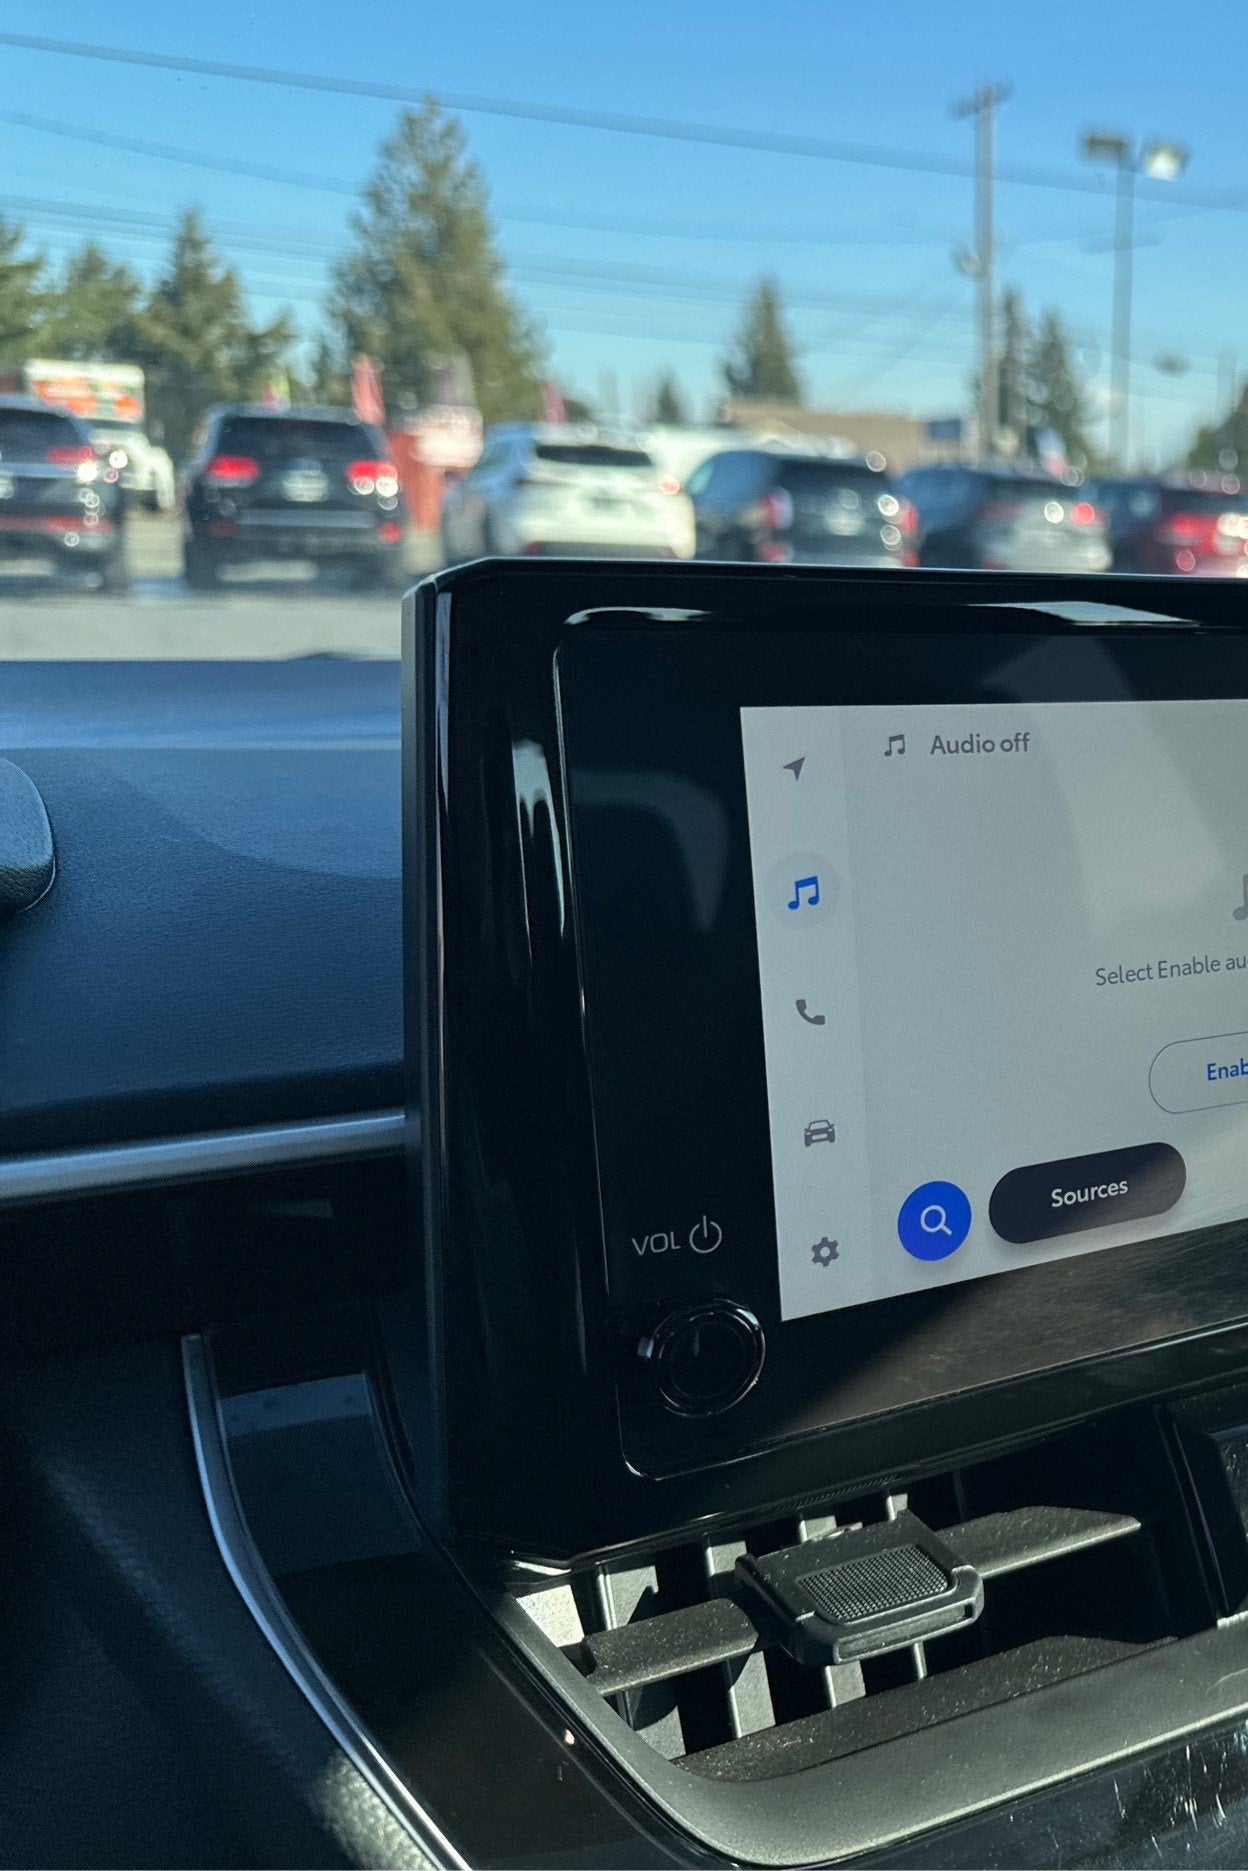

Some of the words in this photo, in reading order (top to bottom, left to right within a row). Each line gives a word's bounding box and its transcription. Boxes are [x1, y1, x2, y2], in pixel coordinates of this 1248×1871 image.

[930, 733, 996, 755] Audio
[1000, 732, 1030, 752] off
[1095, 963, 1154, 986] Select
[1158, 955, 1221, 980] Enable
[1051, 1180, 1129, 1208] Sources
[631, 1230, 682, 1256] VOL
